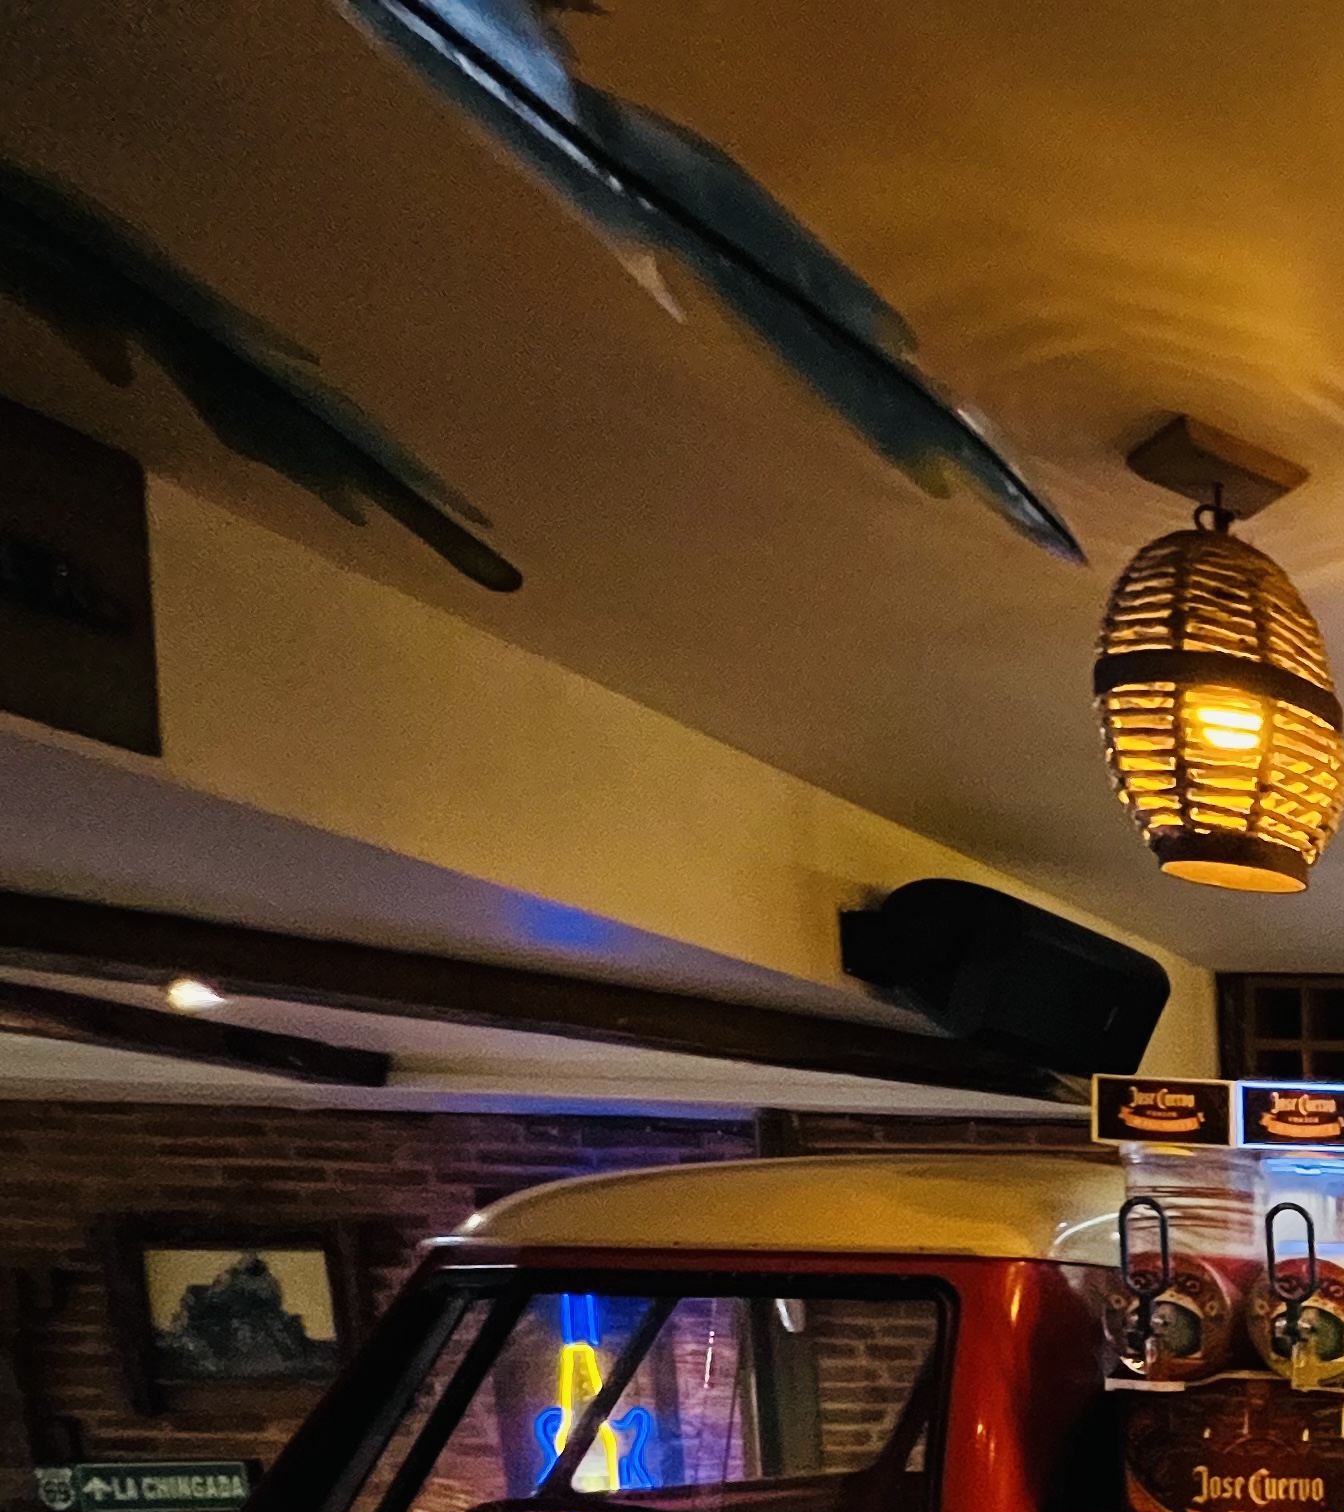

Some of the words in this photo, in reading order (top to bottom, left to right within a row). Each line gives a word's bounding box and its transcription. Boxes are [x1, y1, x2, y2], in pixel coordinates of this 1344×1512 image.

[111, 1476, 139, 1500] LA
[141, 1475, 245, 1500] CHINGADA
[1191, 1465, 1246, 1504] Jose
[1247, 1468, 1325, 1505] Cuervo
